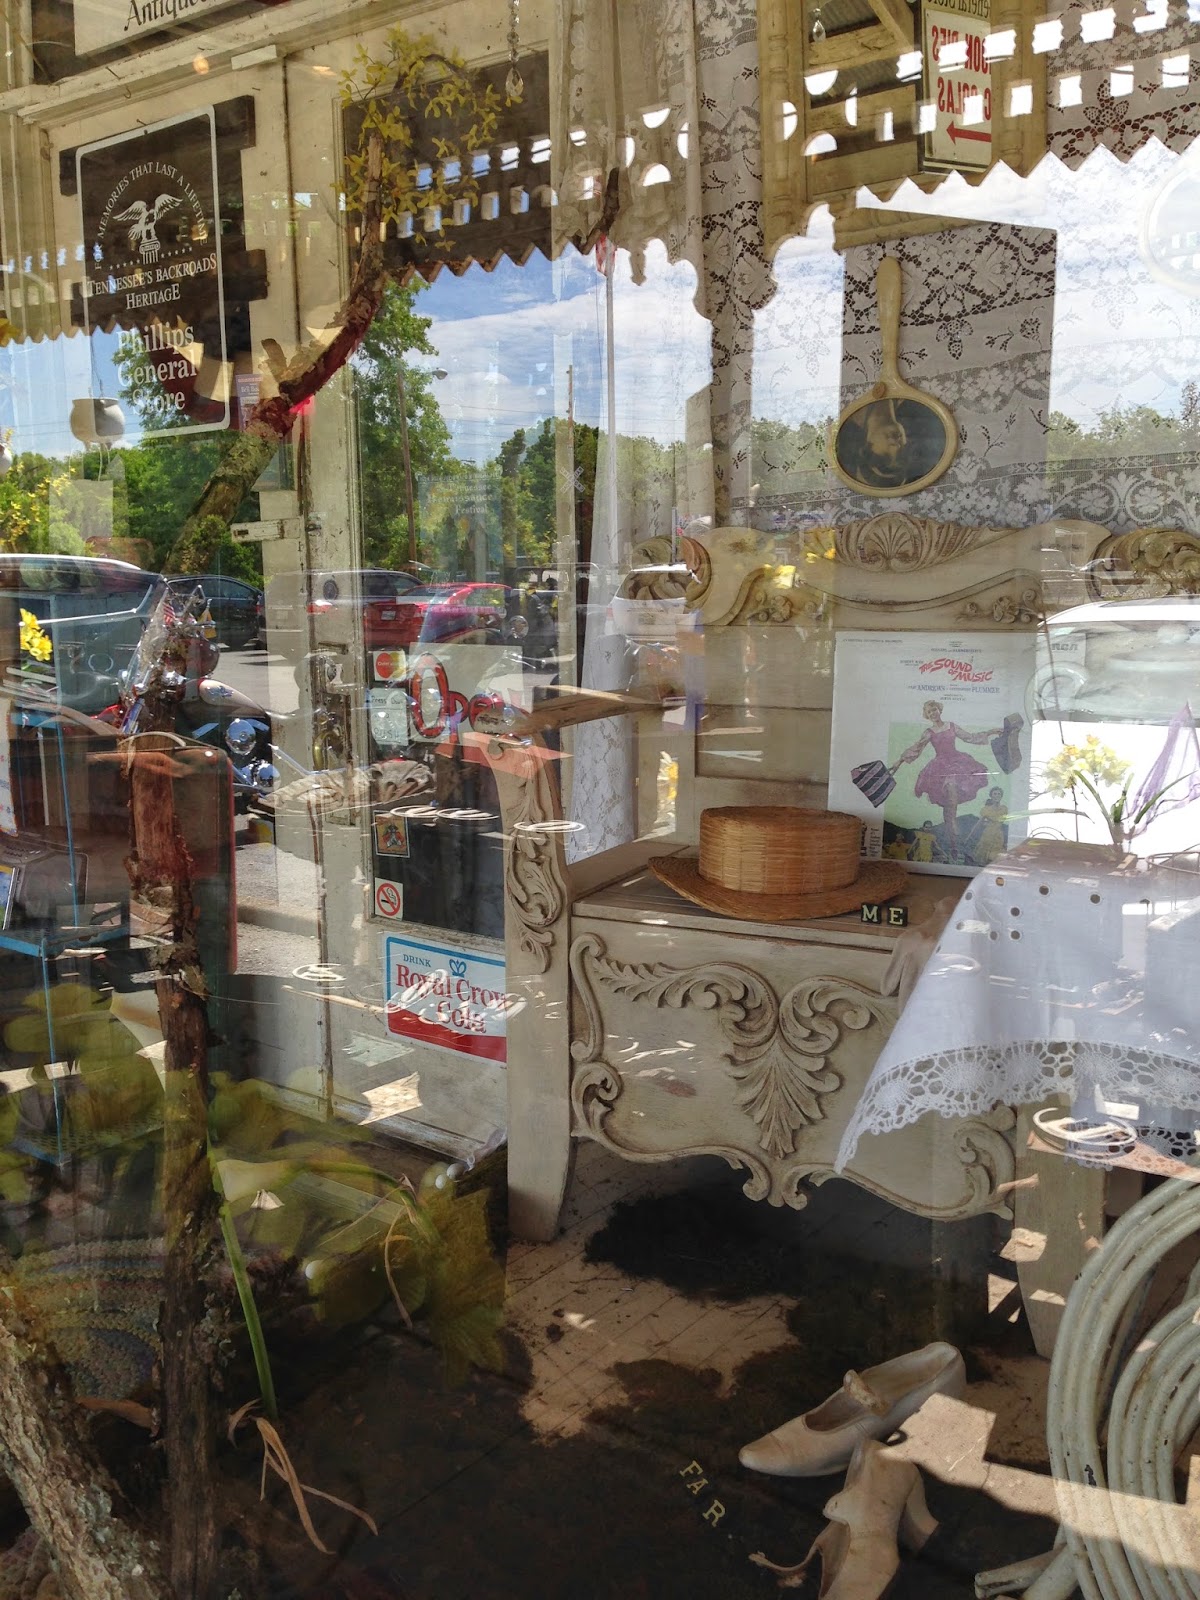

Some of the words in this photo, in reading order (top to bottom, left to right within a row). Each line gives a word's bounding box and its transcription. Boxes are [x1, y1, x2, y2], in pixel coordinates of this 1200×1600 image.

[123, 0, 206, 31] Antiqu
[97, 176, 130, 239] MEMORIES
[129, 162, 154, 181] THAT
[155, 162, 177, 179] LAST
[177, 175, 184, 187] A
[86, 270, 153, 297] TENNESSEE'S
[156, 252, 217, 282] BACKROADS
[125, 283, 181, 310] HERITAGE
[117, 322, 195, 357] Phillips
[117, 350, 197, 388] General
[132, 388, 186, 416] Store
[919, 661, 934, 674] THE
[929, 657, 973, 673] SOUND
[947, 668, 959, 676] OF
[952, 670, 994, 683] MUSIC
[411, 651, 506, 744] Ope
[861, 903, 904, 925] ME
[402, 953, 432, 968] DRINK
[396, 963, 453, 999] Royal
[455, 978, 507, 1007] Crow
[437, 1000, 487, 1034] Cola
[679, 1459, 726, 1528] FAR
